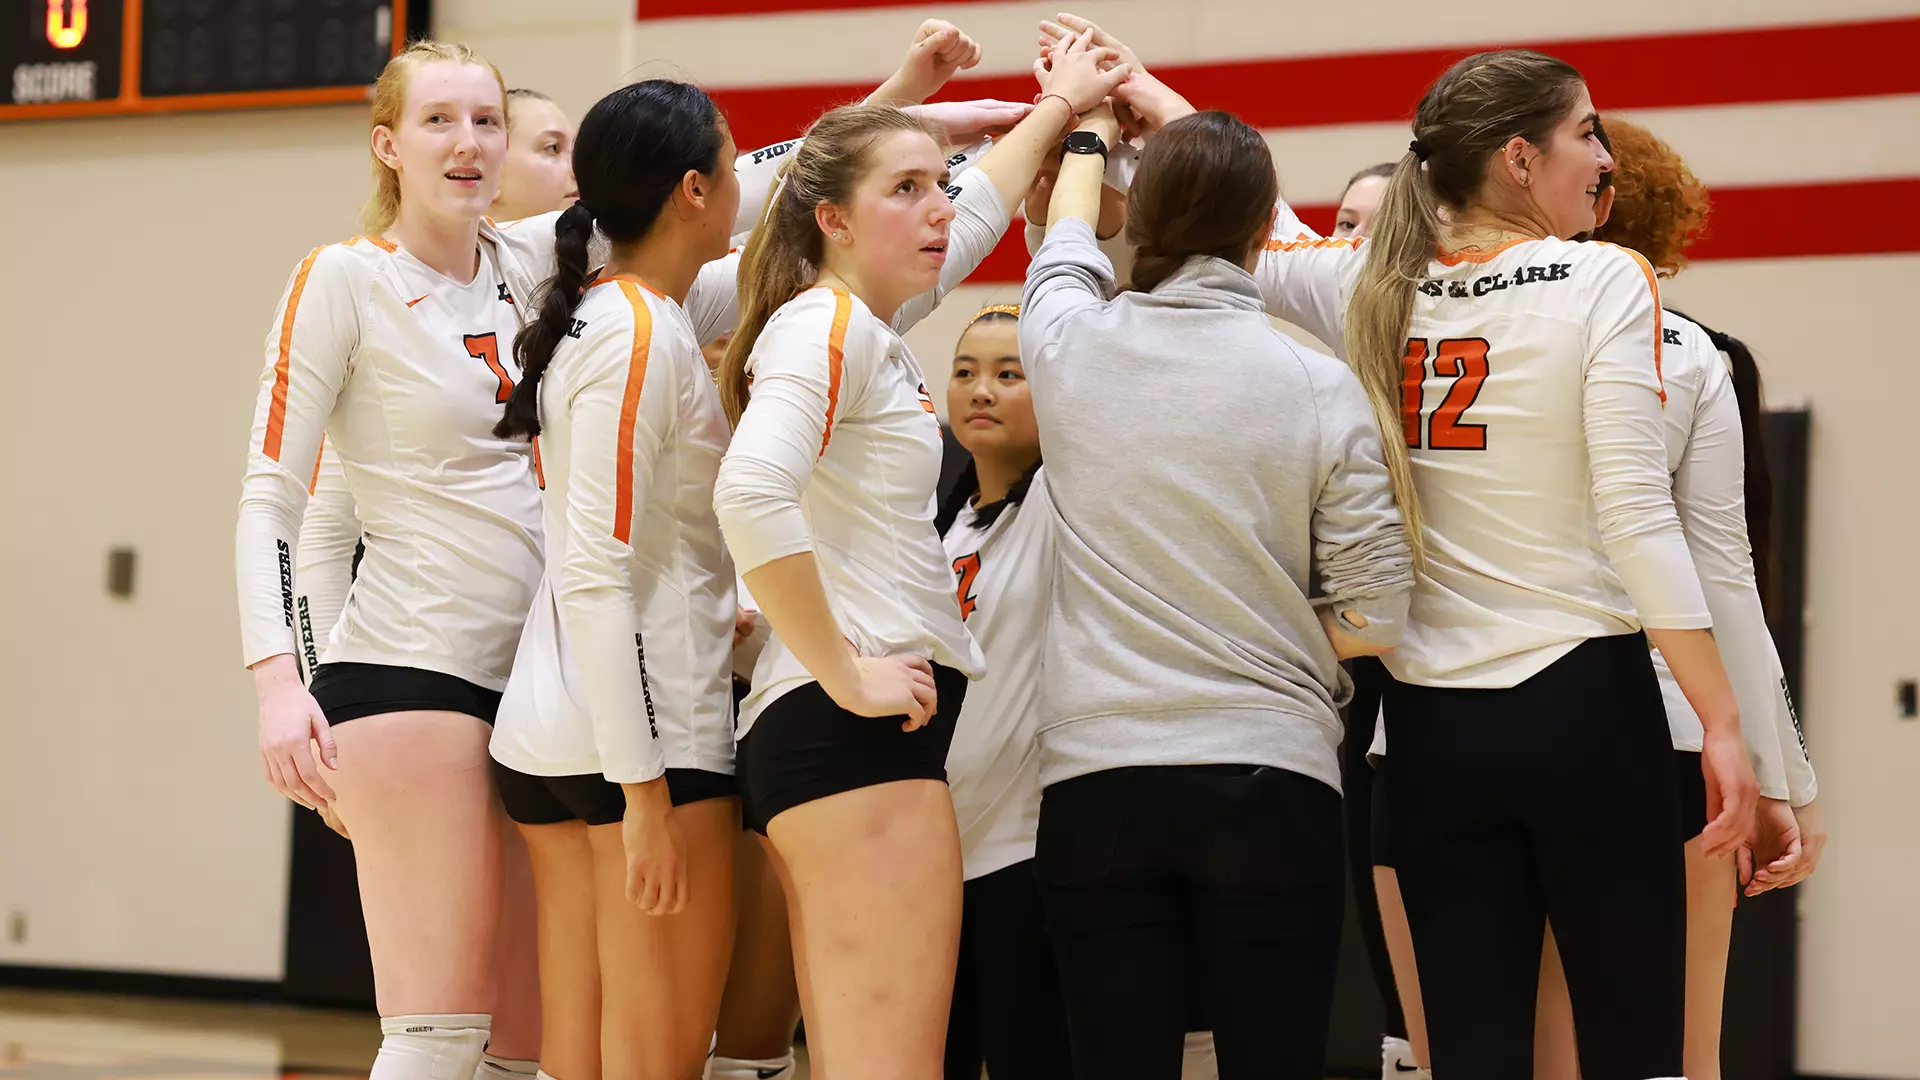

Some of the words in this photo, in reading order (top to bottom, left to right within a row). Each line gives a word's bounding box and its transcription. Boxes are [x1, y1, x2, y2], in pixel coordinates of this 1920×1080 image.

[13, 61, 97, 104] SCORE
[1473, 263, 1572, 297] CLARK
[463, 332, 515, 404] 7
[1400, 337, 1490, 450] 12
[298, 595, 319, 676] IONEERS
[635, 633, 659, 739] PIONEERS
